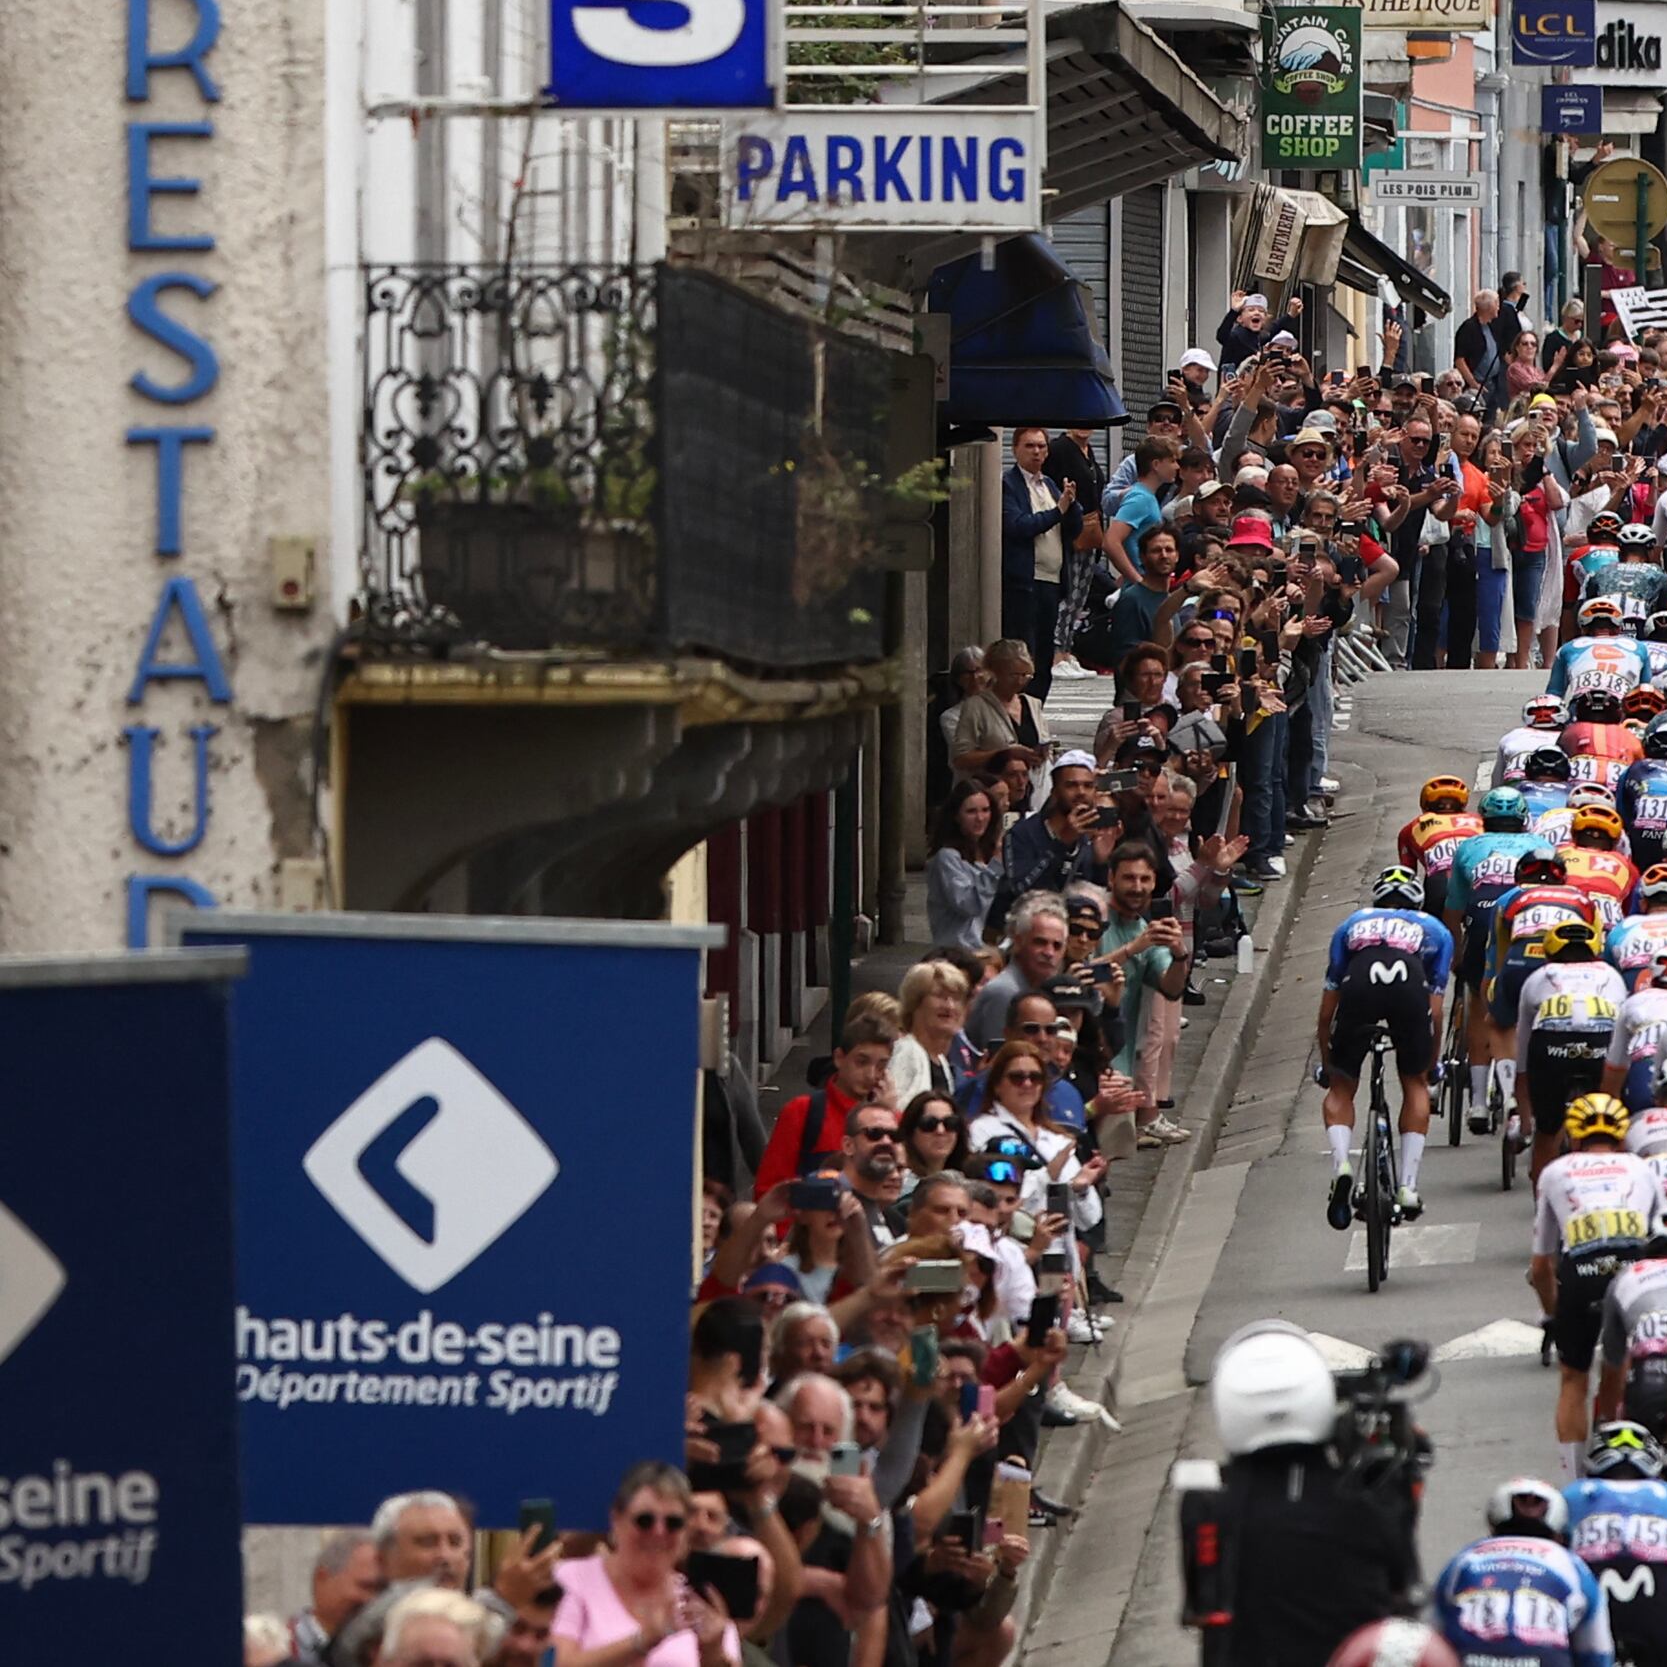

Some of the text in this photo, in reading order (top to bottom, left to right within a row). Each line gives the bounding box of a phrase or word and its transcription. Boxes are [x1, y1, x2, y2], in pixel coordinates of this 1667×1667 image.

[1519, 14, 1586, 36] LCL
[1266, 114, 1354, 136] COFFEE
[1279, 137, 1340, 158] SHOP
[737, 135, 1025, 202] PARKING
[1383, 183, 1473, 197] LES POIS PLUM
[1577, 672, 1602, 689] 183
[1572, 760, 1592, 779] 34
[1546, 995, 1568, 1017] 16
[1571, 1210, 1642, 1244] 18 18
[485, 1368, 620, 1416] Sportif
